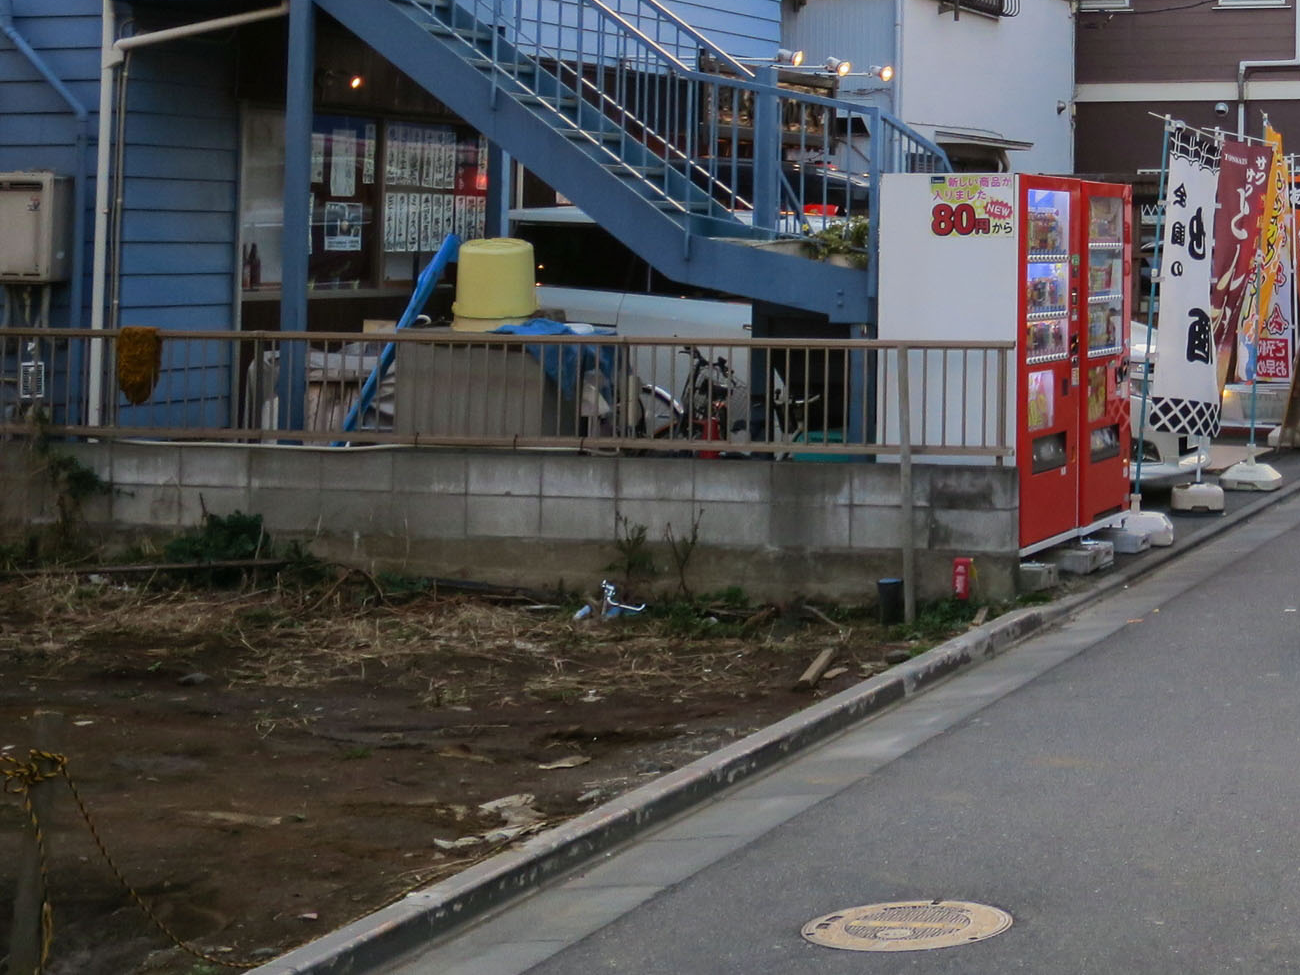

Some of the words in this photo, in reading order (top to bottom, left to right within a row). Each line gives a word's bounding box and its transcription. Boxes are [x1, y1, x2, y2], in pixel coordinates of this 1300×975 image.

[948, 176, 1012, 187] 新しい商品が
[932, 189, 987, 201] 入りました
[986, 203, 1011, 217] NEW
